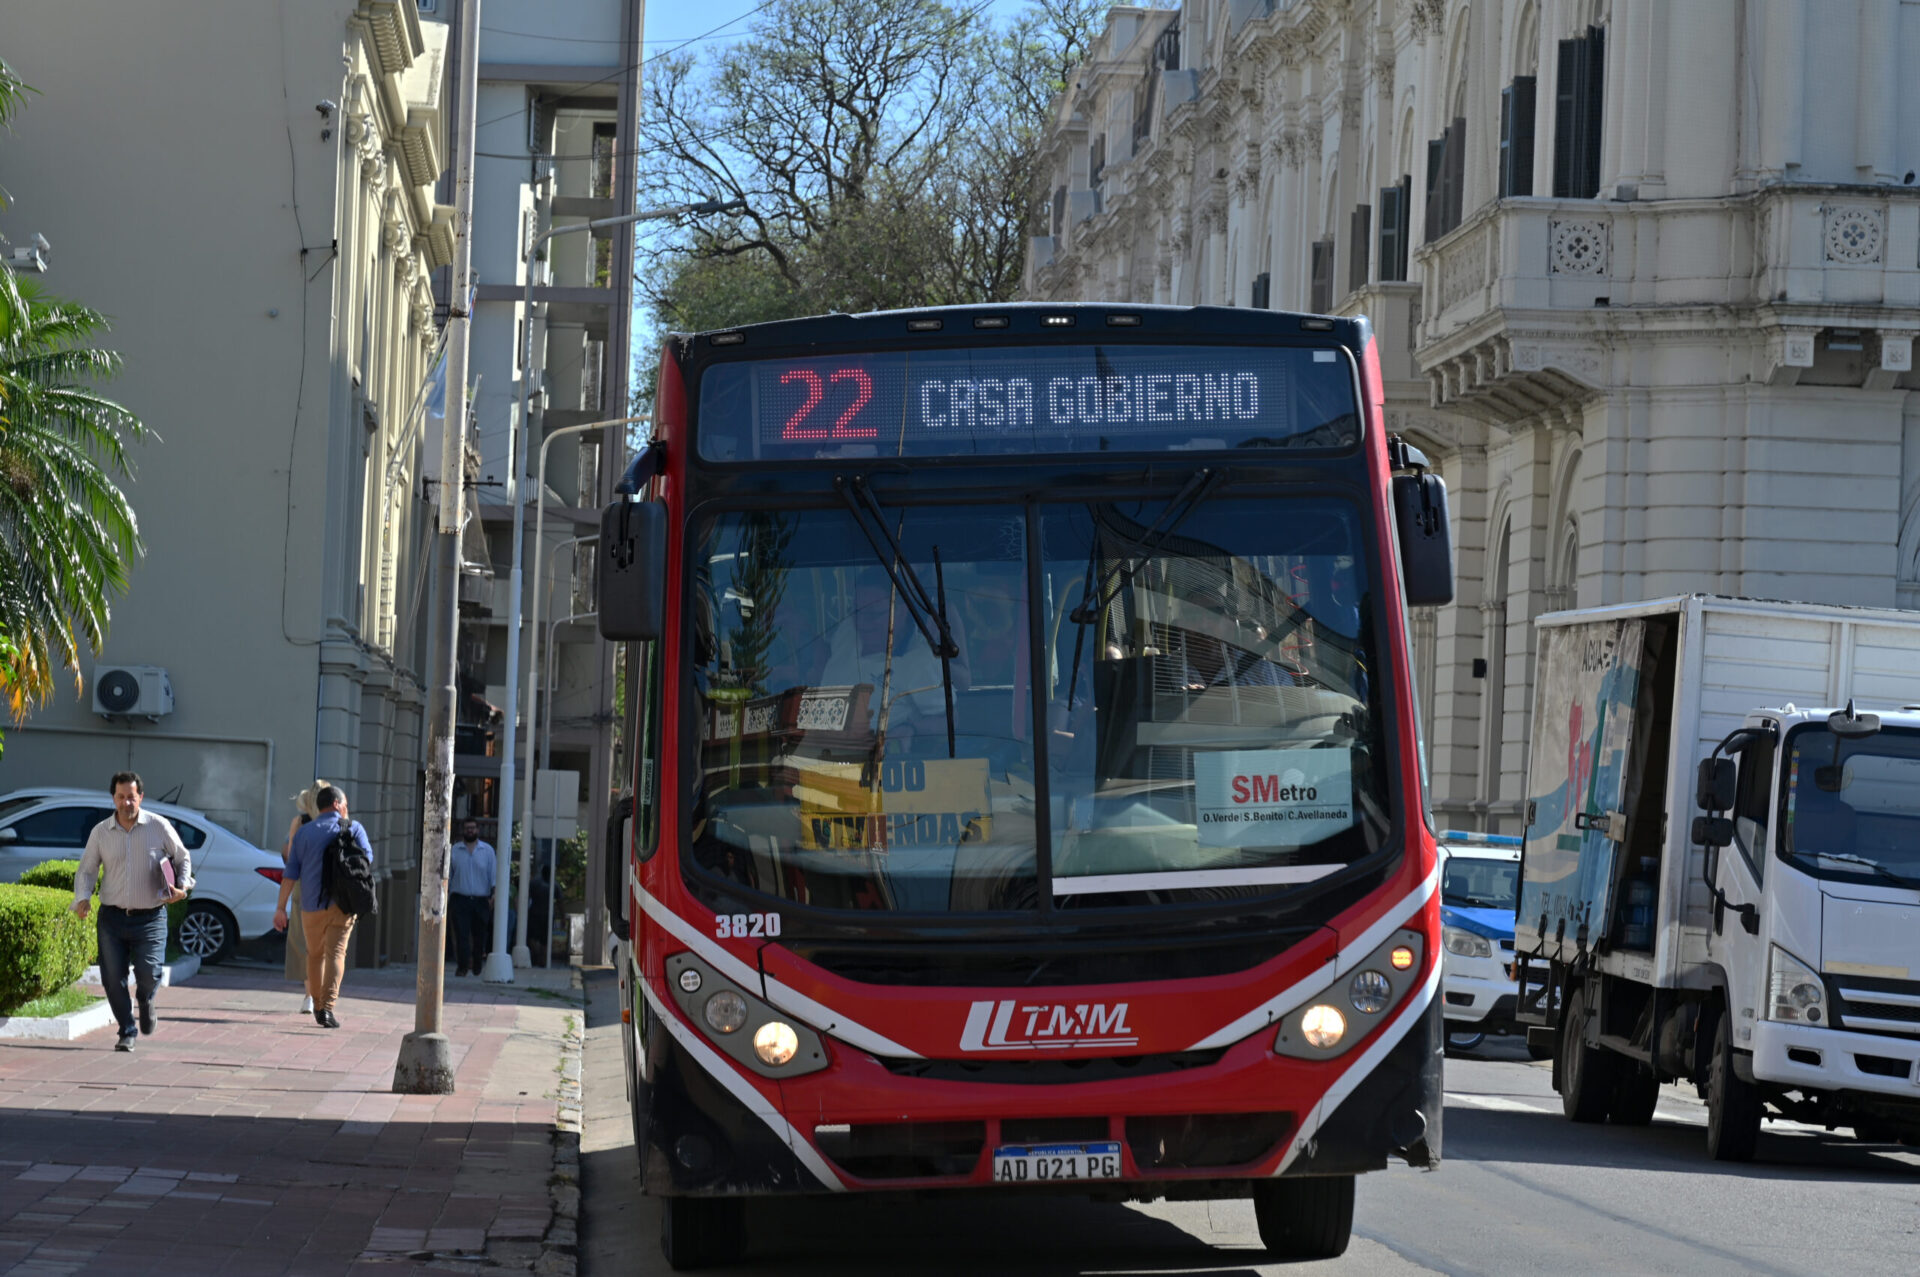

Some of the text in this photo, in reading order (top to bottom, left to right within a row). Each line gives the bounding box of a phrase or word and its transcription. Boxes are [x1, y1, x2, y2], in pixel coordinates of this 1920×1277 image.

[780, 368, 1259, 439] 22 CASA GOBIERNO
[1231, 774, 1318, 804] SMetro
[811, 811, 983, 849] VIVENDAS
[715, 912, 781, 938] 3820
[1001, 1155, 1115, 1181] AD 021 PG
